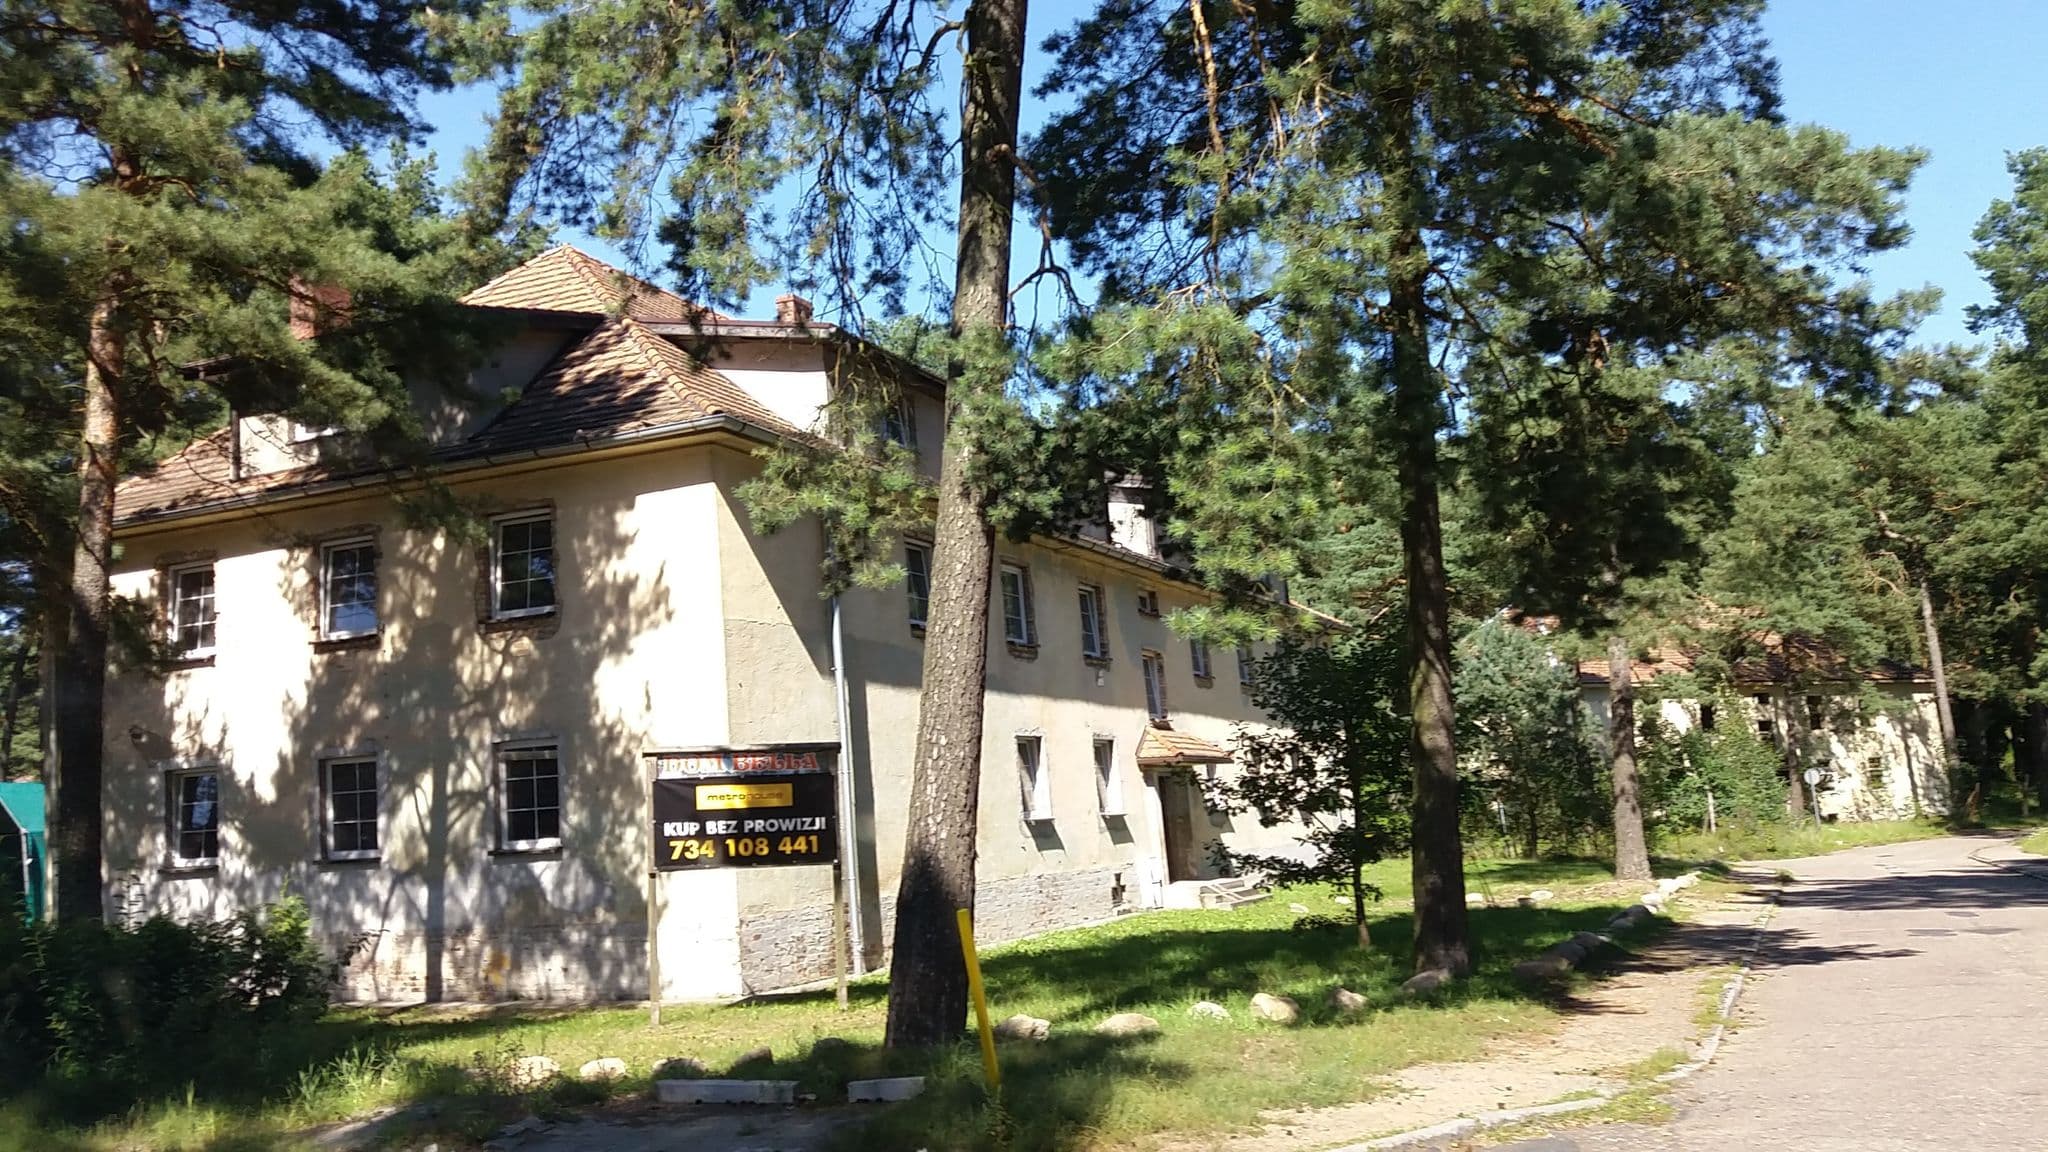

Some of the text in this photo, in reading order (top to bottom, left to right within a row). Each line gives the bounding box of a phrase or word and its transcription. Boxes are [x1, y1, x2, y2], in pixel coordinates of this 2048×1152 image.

[731, 752, 819, 772] BELLA
[707, 792, 783, 801] metrohouse
[663, 816, 827, 837] KUP BEZ PROWIZJI
[669, 835, 819, 860] 734 108 441
